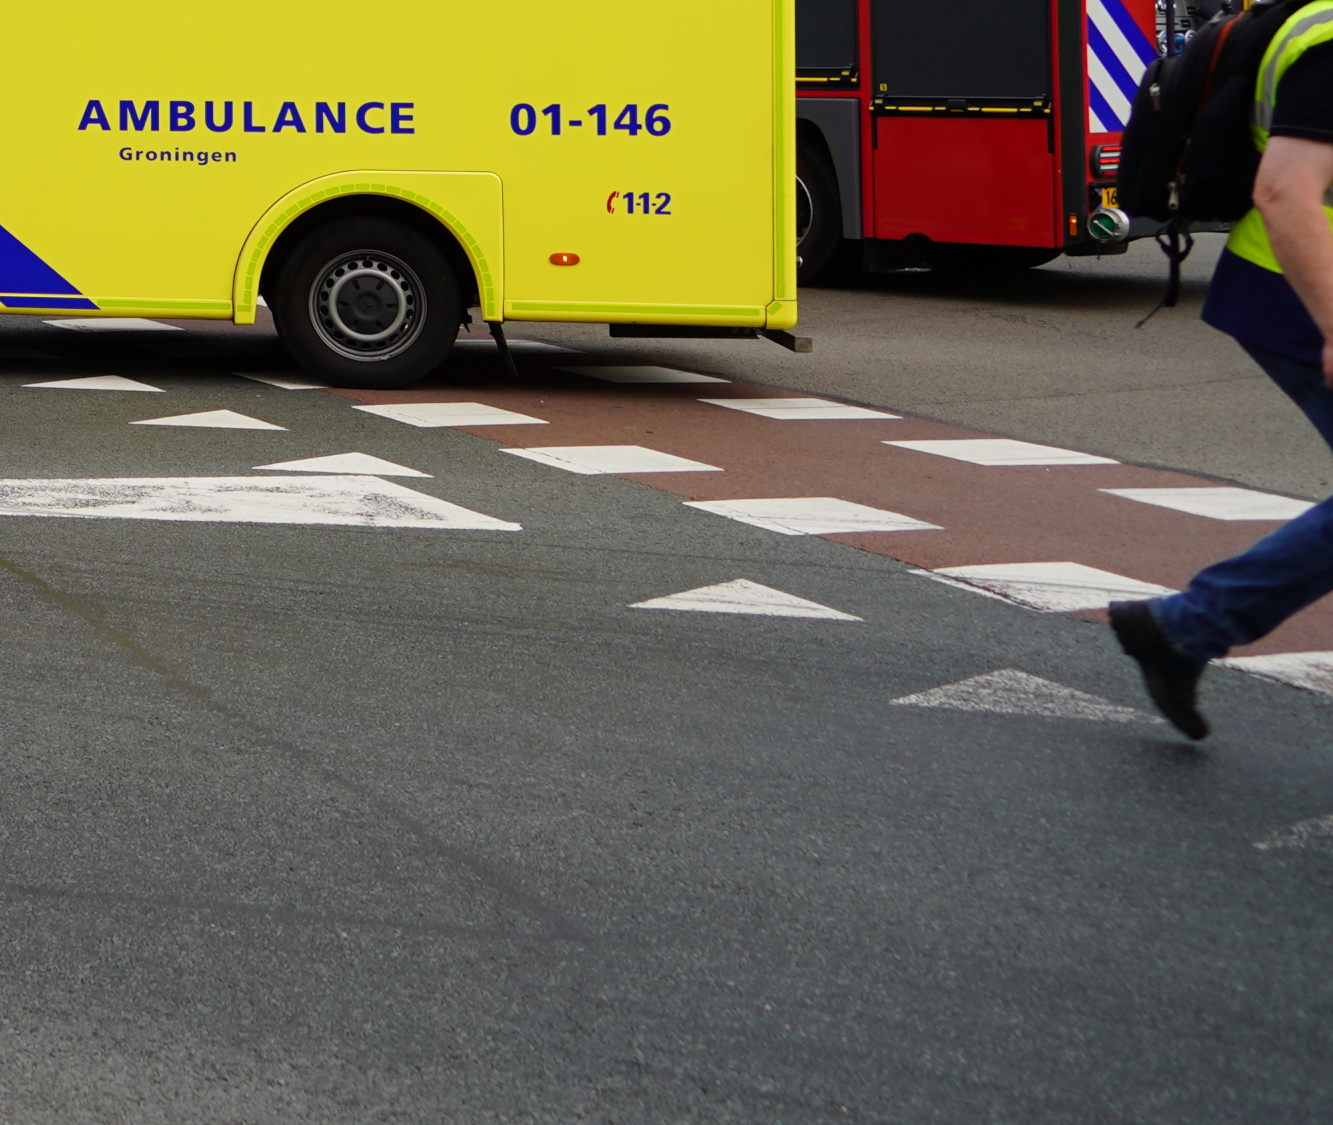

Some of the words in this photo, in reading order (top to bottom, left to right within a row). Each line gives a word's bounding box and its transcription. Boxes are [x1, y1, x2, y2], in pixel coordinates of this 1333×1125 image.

[77, 99, 416, 134] AMBULANCE
[510, 102, 672, 137] 01-146
[119, 147, 237, 166] Groningen
[622, 191, 672, 215] 1-1-2
